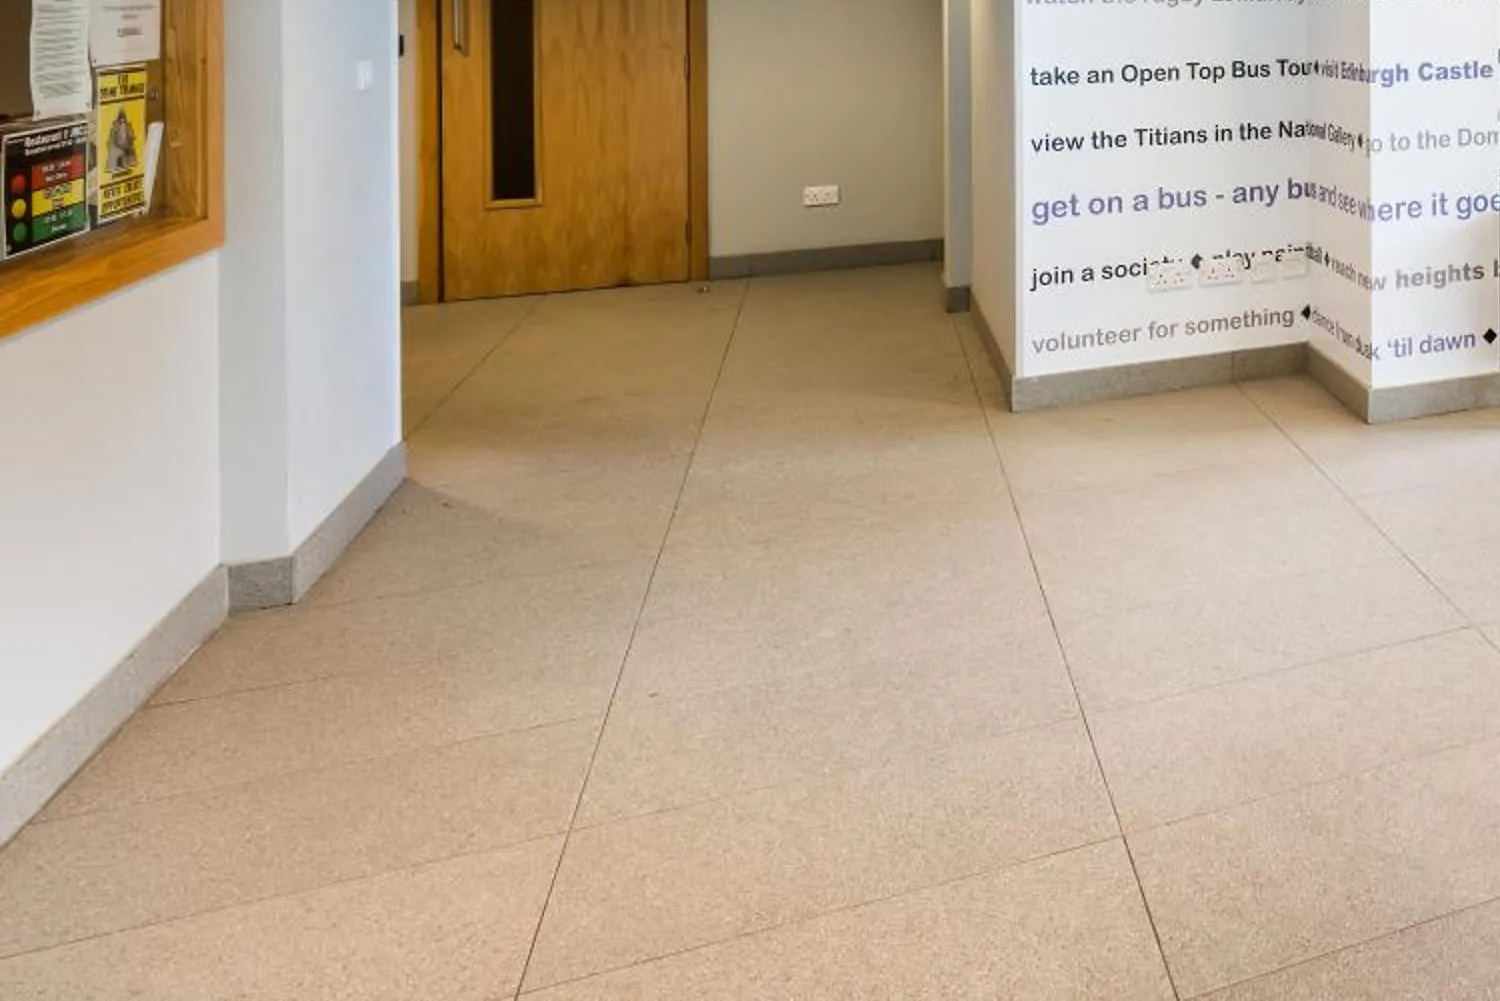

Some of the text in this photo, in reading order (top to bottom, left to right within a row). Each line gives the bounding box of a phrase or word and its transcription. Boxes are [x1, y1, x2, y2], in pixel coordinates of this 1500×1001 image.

[1030, 58, 1313, 86] take an Open Top Bus Tour
[1418, 60, 1494, 82] Castle
[1031, 133, 1085, 153] view
[1091, 131, 1127, 151] the
[1134, 125, 1207, 148] Titians
[1214, 124, 1233, 142] in
[1239, 122, 1272, 141] the
[1390, 132, 1411, 152] to
[1417, 129, 1451, 150] the
[1032, 193, 1081, 225] get
[1088, 191, 1123, 214] on
[1133, 193, 1149, 212] a
[1158, 186, 1207, 210] bus
[1232, 183, 1280, 205] any
[1287, 177, 1316, 200] bus
[1431, 191, 1449, 216] it
[1030, 256, 1183, 293] join a soci
[1396, 260, 1485, 289] heights
[1031, 305, 1296, 354] volunteer for something
[1420, 331, 1477, 355] dawn
